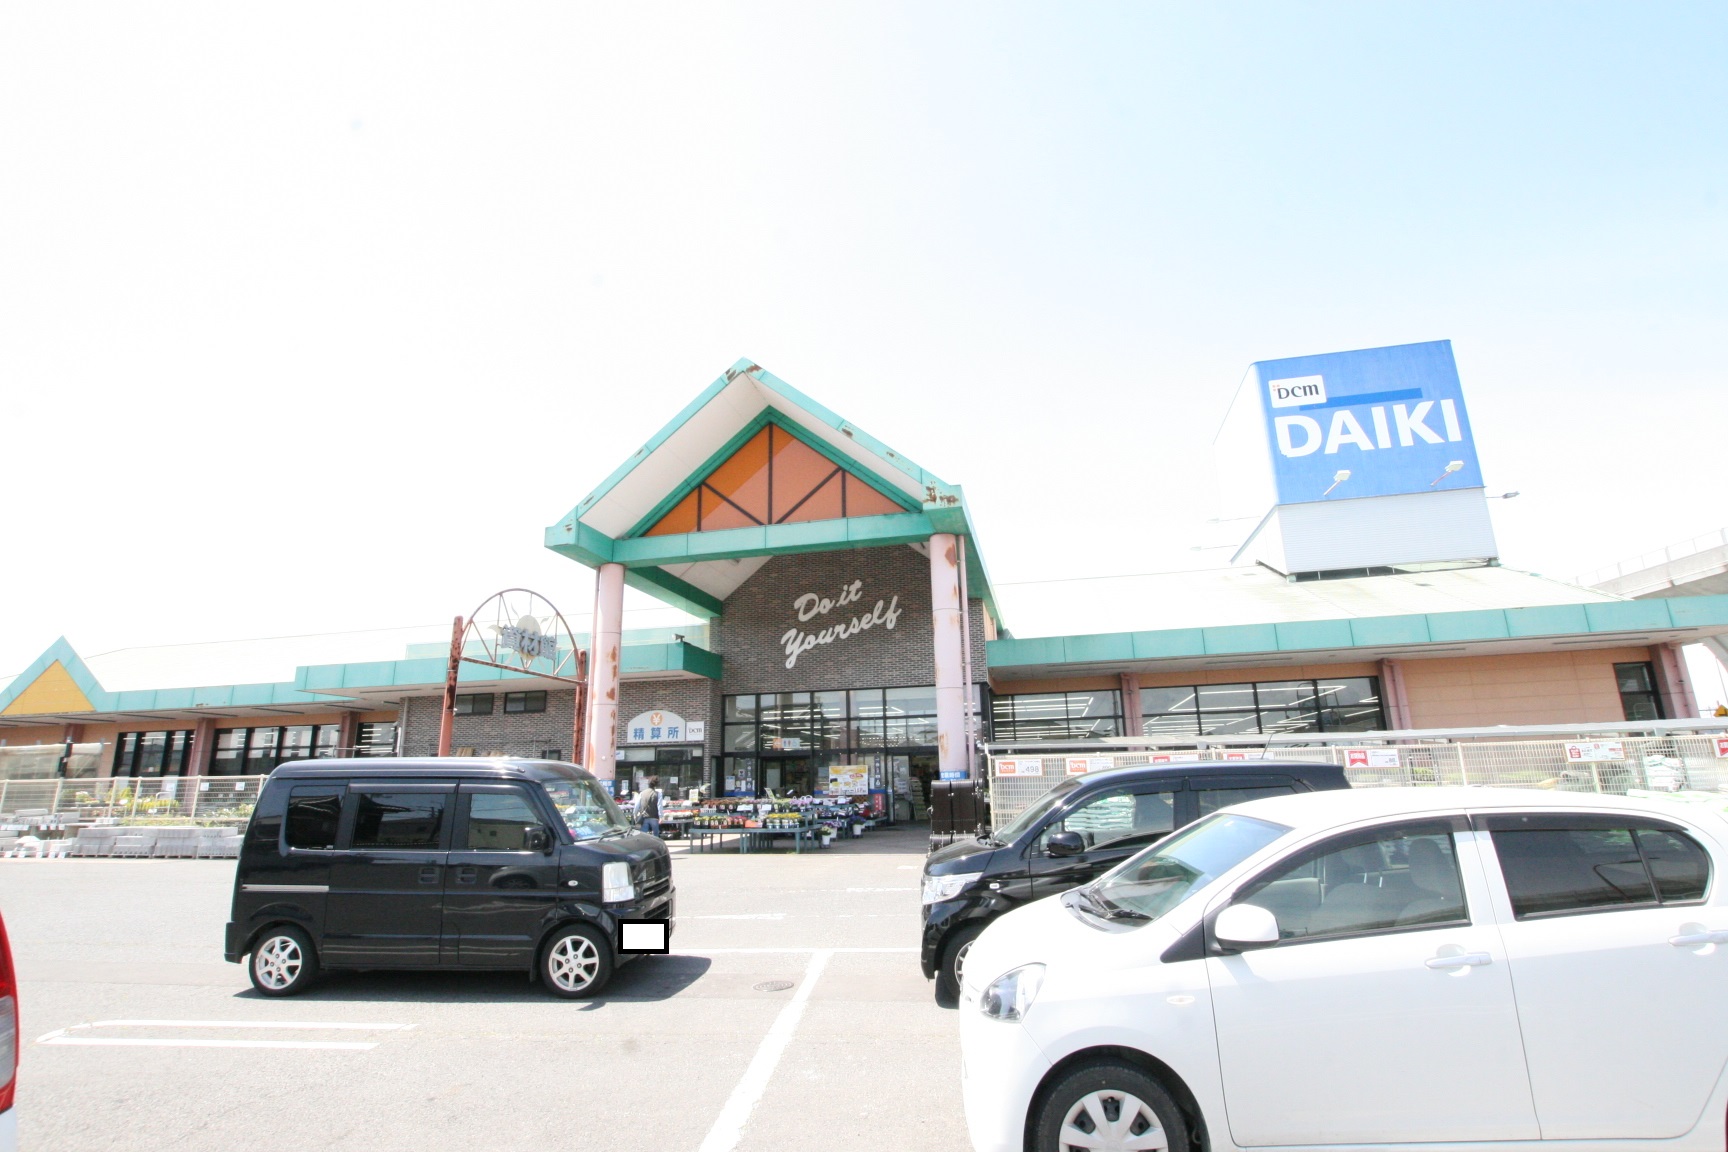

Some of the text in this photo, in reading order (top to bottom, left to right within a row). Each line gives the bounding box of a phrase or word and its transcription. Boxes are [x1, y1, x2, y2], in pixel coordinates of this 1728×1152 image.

[1274, 398, 1462, 458] DAIKI
[793, 579, 863, 622] Do it
[780, 595, 902, 669] Yourself
[633, 726, 679, 740] 精算所
